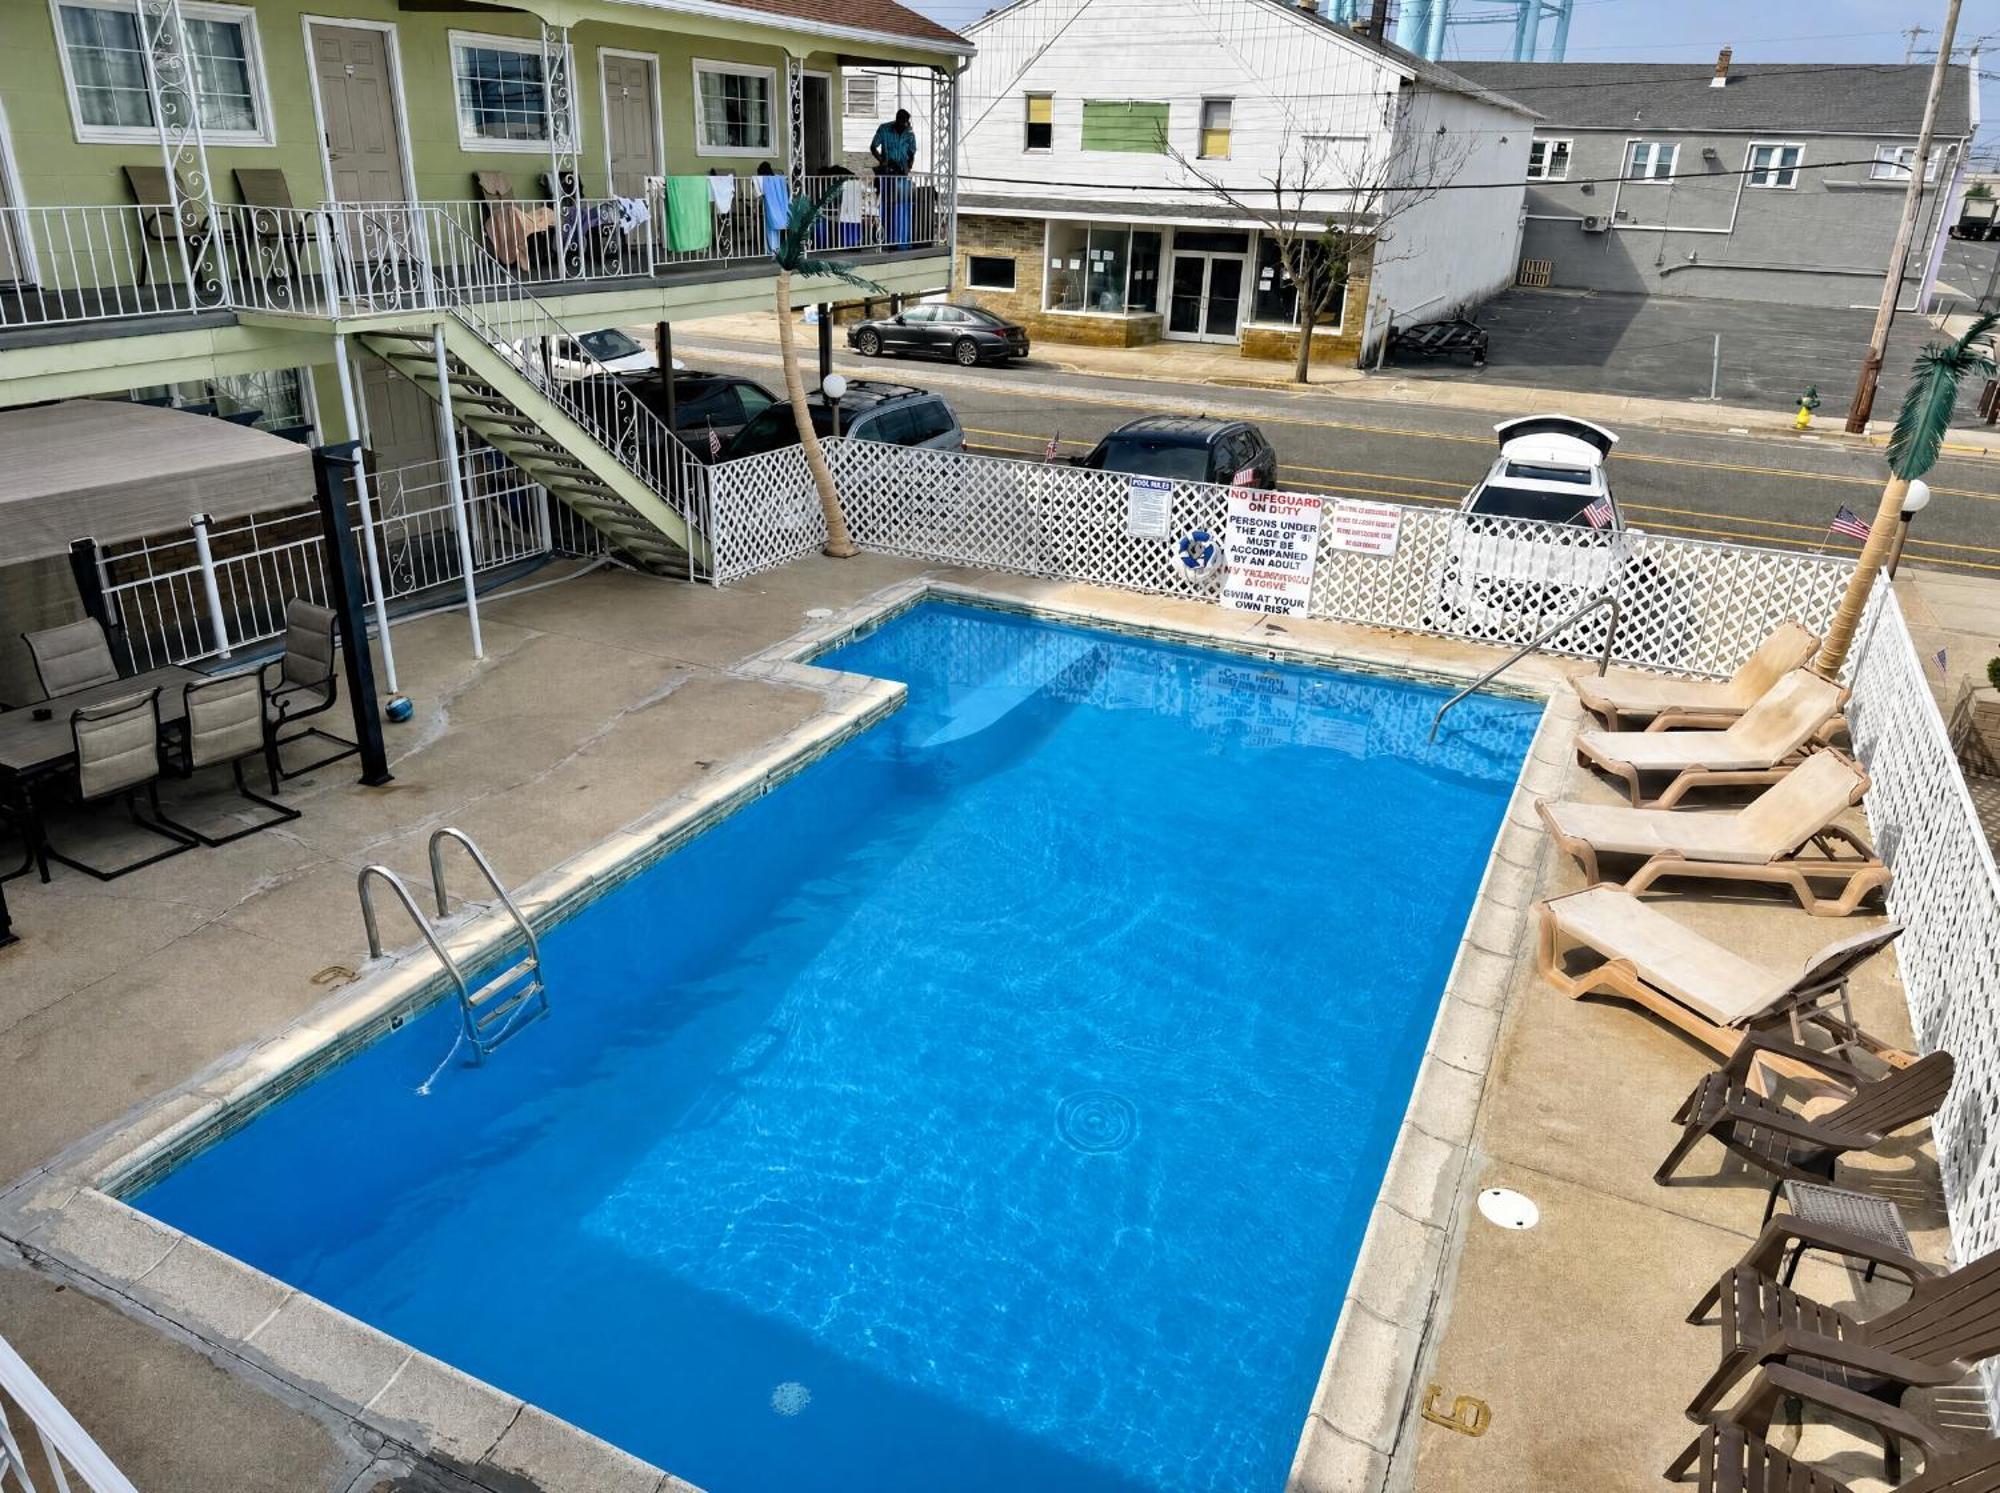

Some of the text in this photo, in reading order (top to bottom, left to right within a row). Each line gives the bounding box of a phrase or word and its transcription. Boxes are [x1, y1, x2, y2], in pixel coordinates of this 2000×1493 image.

[1132, 480, 1170, 490] POOL RULES
[1230, 490, 1321, 508] NO LIFEGUARD
[1249, 502, 1301, 516] ON DUTY
[1229, 515, 1317, 533] PERSONS UNDER
[1235, 526, 1256, 535] THE
[1258, 529, 1280, 539] AGE
[1283, 532, 1296, 540] OF
[1246, 537, 1295, 550] MUST BE
[1230, 544, 1308, 561] ACCOMPANIED
[1234, 554, 1301, 570] BY AN ADULT
[1235, 601, 1290, 615] OWN RISK
[1256, 594, 1271, 603] AT
[1274, 596, 1305, 609] YOUR
